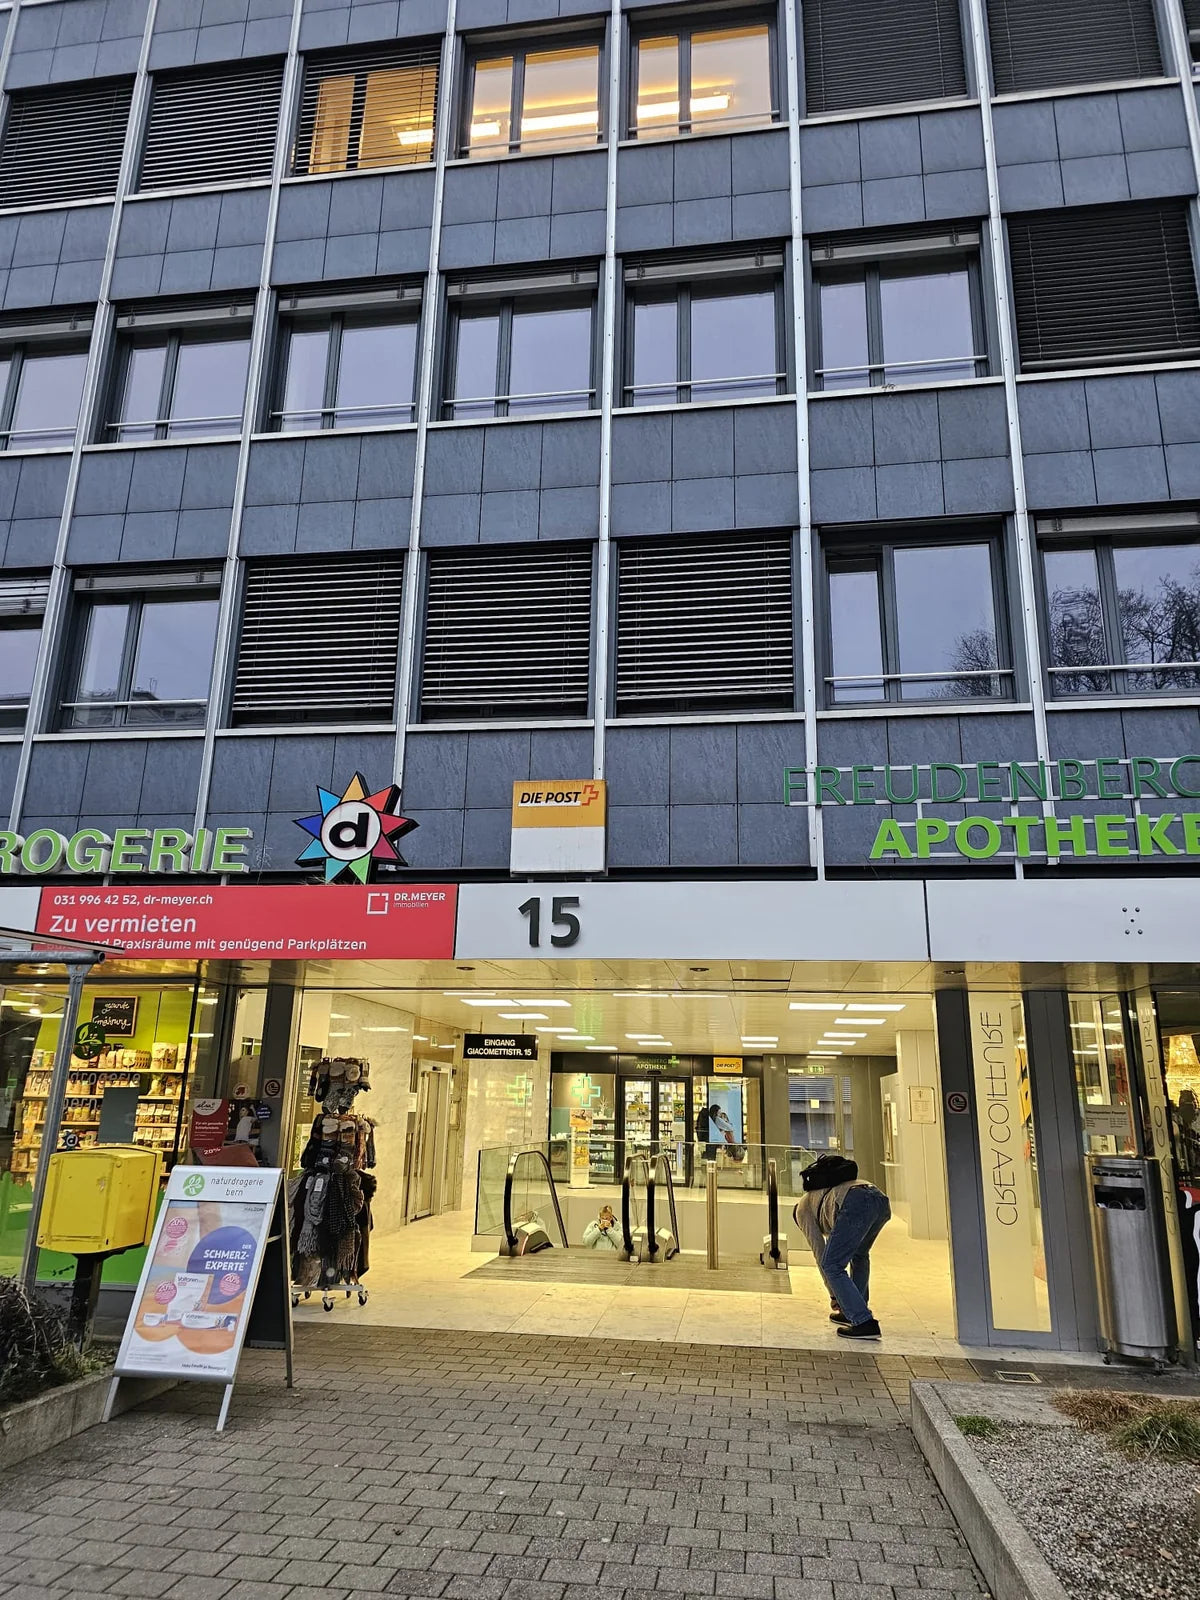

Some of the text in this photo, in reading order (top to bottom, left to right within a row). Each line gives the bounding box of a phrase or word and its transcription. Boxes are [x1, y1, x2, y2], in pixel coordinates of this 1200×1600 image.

[520, 790, 581, 804] DIE POST
[54, 894, 213, 907] 031 996 42 52, dr-meyer.ch
[394, 892, 446, 901] DR.MEYER
[49, 914, 197, 933] Zu vermieten
[518, 896, 581, 948] 15
[112, 938, 191, 950] Praxisräume
[195, 938, 216, 950] mit
[219, 938, 284, 951] genügend
[287, 938, 368, 951] Parkplätzen
[484, 1038, 516, 1047] EINGANG
[467, 1048, 532, 1056] GIACOMETTISTR. 15
[211, 1177, 264, 1188] naturdrogerie
[203, 1249, 250, 1260] SCHMERZ-
